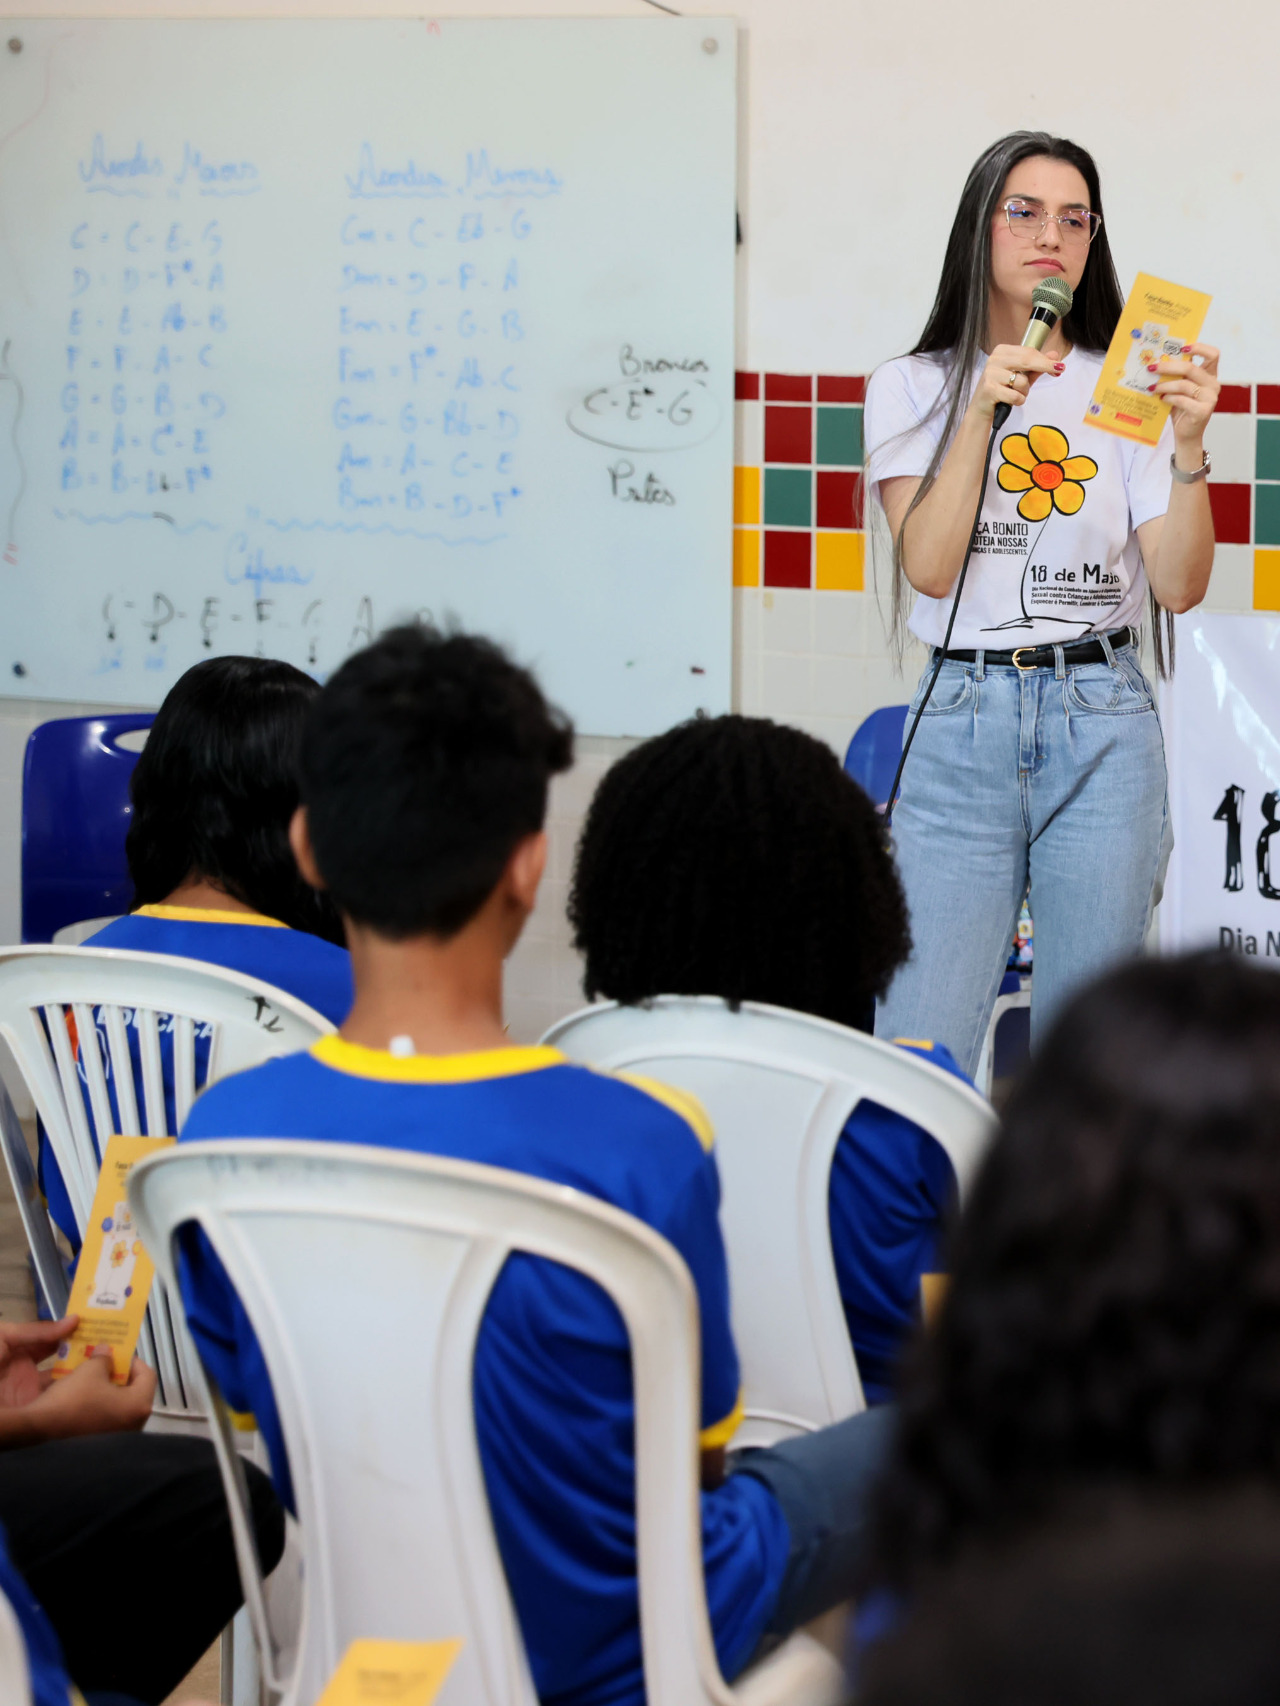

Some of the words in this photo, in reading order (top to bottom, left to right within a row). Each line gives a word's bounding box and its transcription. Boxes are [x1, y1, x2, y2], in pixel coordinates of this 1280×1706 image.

[992, 521, 1029, 536] BONITO
[997, 537, 1028, 548] NOSSAS
[1030, 564, 1047, 583] 18
[1054, 568, 1076, 582] de
[1218, 926, 1258, 956] Dia
